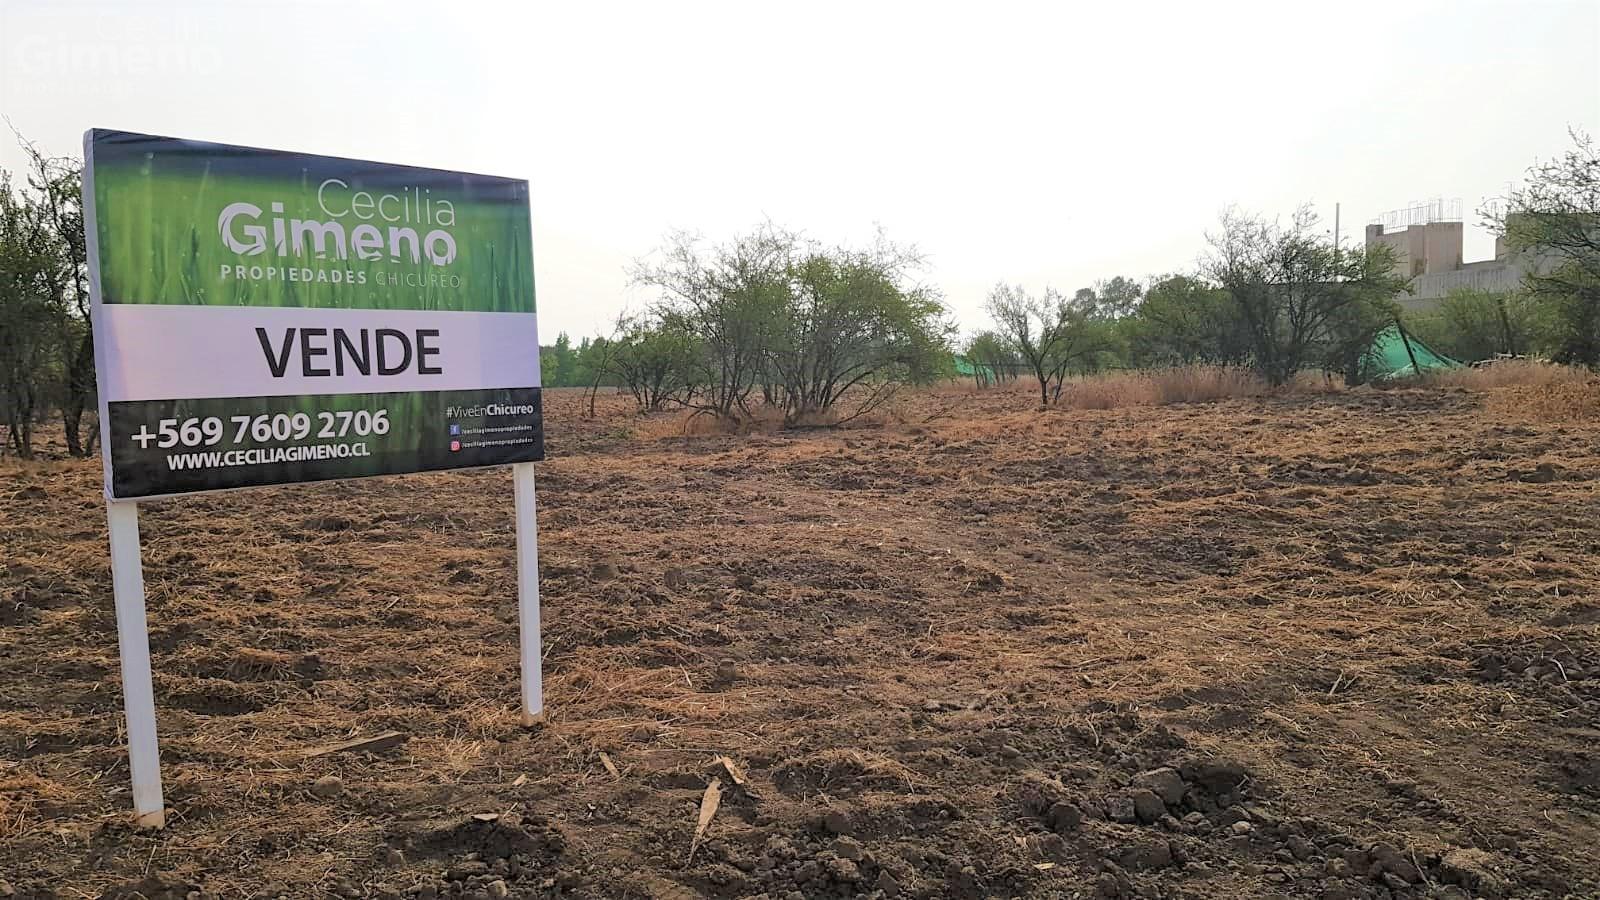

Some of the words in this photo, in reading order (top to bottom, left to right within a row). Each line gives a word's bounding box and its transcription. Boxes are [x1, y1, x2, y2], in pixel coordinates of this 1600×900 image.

[318, 178, 456, 226] Cecilia
[218, 201, 457, 266] Gimeno
[220, 264, 367, 285] PROPIEDADES
[375, 271, 461, 289] CHICUREO
[255, 327, 443, 378] VENDE
[131, 416, 224, 449] +569
[230, 414, 311, 444] 7609
[317, 409, 390, 439] 2706
[446, 403, 534, 418] #ViveEnChicureo
[166, 443, 370, 471] WWW.CECILIAGIMENO.CL
